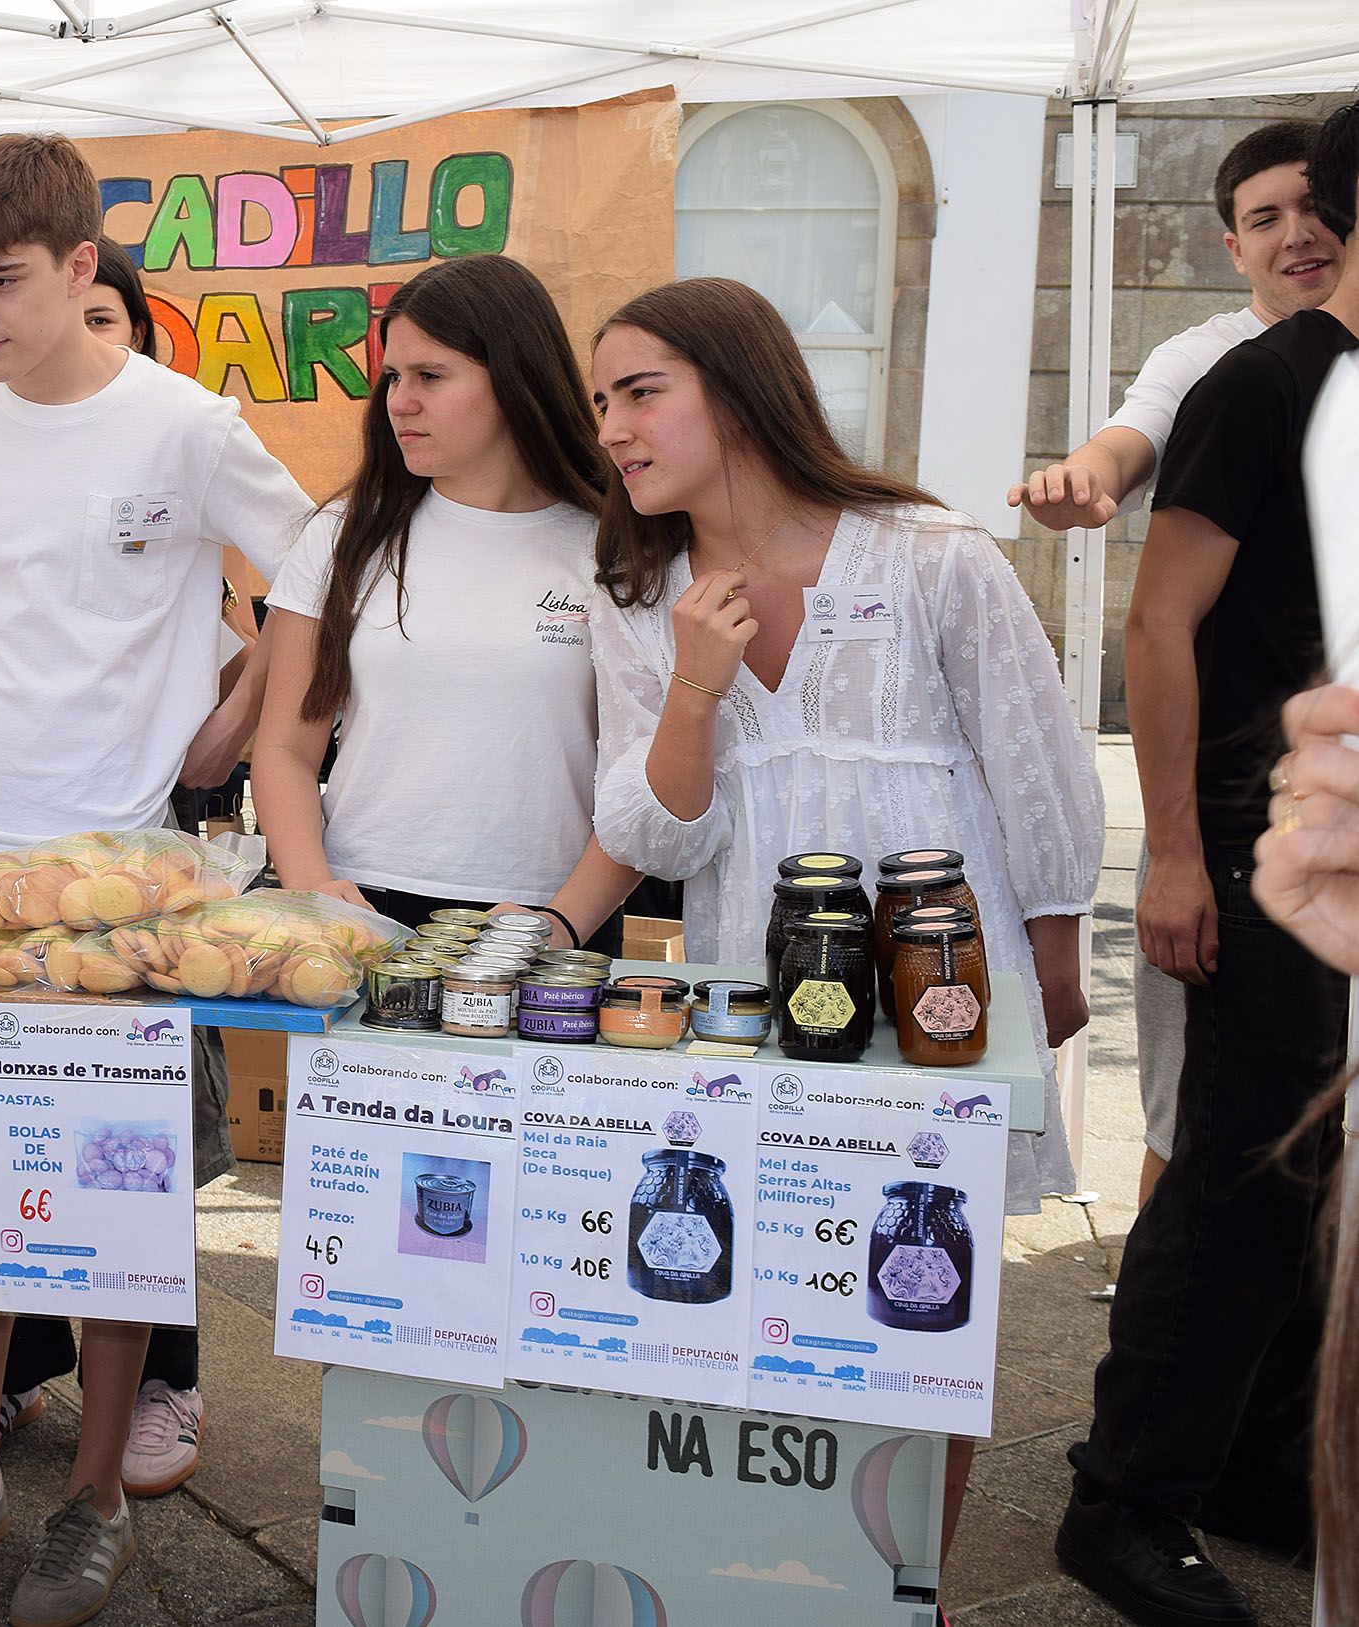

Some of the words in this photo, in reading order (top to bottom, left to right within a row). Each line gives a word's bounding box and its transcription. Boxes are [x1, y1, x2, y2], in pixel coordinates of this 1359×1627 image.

[536, 590, 588, 612] Lisboa
[535, 620, 564, 633] boas
[463, 996, 493, 1007] ZUBIA
[544, 991, 560, 1000] Paté
[561, 991, 585, 1000] ibérico
[22, 1023, 92, 1035] colaborando
[96, 1027, 120, 1036] con:
[524, 1017, 556, 1032] ZUBIA
[562, 1020, 578, 1028] Paté
[63, 1062, 86, 1077] de
[92, 1063, 187, 1081] Trasmañó
[342, 1063, 418, 1080] colaborando
[421, 1071, 447, 1083] con:
[307, 1076, 340, 1085] COOPILLA
[567, 1073, 647, 1088] colaborando
[651, 1080, 678, 1090] con:
[530, 1085, 565, 1093] COOPILLA
[768, 1103, 805, 1113] COOPILLA
[807, 1092, 892, 1108] colaborando
[896, 1100, 925, 1111] con:
[296, 1093, 314, 1111] A
[322, 1096, 397, 1120] Tenda
[404, 1104, 434, 1124] da
[442, 1108, 513, 1133] Loura
[524, 1111, 565, 1126] COVA
[569, 1115, 591, 1127] DA
[594, 1117, 652, 1132] ABELLA
[8, 1126, 61, 1139] BOLAS
[523, 1131, 549, 1144] Mel
[553, 1134, 571, 1146] da
[576, 1135, 607, 1148] Raia
[24, 1143, 45, 1155] DE
[760, 1131, 805, 1145] COVA
[809, 1135, 832, 1148] DA
[835, 1138, 897, 1153] ABELLA
[311, 1144, 346, 1159] Paté
[350, 1149, 369, 1161] de
[523, 1147, 557, 1160] Seca
[12, 1158, 63, 1173] LIMÓN
[310, 1160, 380, 1179] XABARÍN
[522, 1162, 549, 1175] (De
[552, 1165, 612, 1182] Bosque)
[759, 1157, 787, 1171] Mel
[791, 1159, 819, 1173] das
[310, 1177, 370, 1194] trufado.
[758, 1173, 808, 1188] Serras
[813, 1178, 852, 1192] Altas
[19, 1188, 52, 1222] 6€
[427, 1198, 462, 1213] ZUBIA
[757, 1190, 836, 1209] (Milflores)
[308, 1208, 355, 1224] Prezo:
[521, 1208, 543, 1220] 0,5
[547, 1210, 567, 1223] Kg
[581, 1210, 614, 1234] 6€
[756, 1221, 779, 1234] 0,5
[783, 1223, 804, 1237] Kg
[815, 1218, 859, 1246] 6€
[305, 1234, 343, 1265] 4€
[520, 1253, 540, 1265] 1,0
[543, 1256, 563, 1269] Kg
[570, 1257, 613, 1280] 10€
[127, 1274, 186, 1286] DEPUTACIÓN
[754, 1268, 773, 1281] 1,0
[778, 1270, 799, 1285] Kg
[805, 1271, 858, 1297] 10€
[127, 1284, 187, 1294] PONTEVEDRA
[434, 1330, 497, 1346] DEPUTACIÓN
[434, 1339, 498, 1354] PONTEVEDRA
[672, 1346, 739, 1362] DEPUTACIÓN
[672, 1356, 739, 1371] PONTEVEDRA
[817, 1380, 833, 1388] SAN
[913, 1374, 984, 1391] DEPUTACIÓN
[912, 1384, 984, 1400] PONTEVEDRA
[646, 1410, 714, 1478] NA
[737, 1420, 838, 1491] ESO
